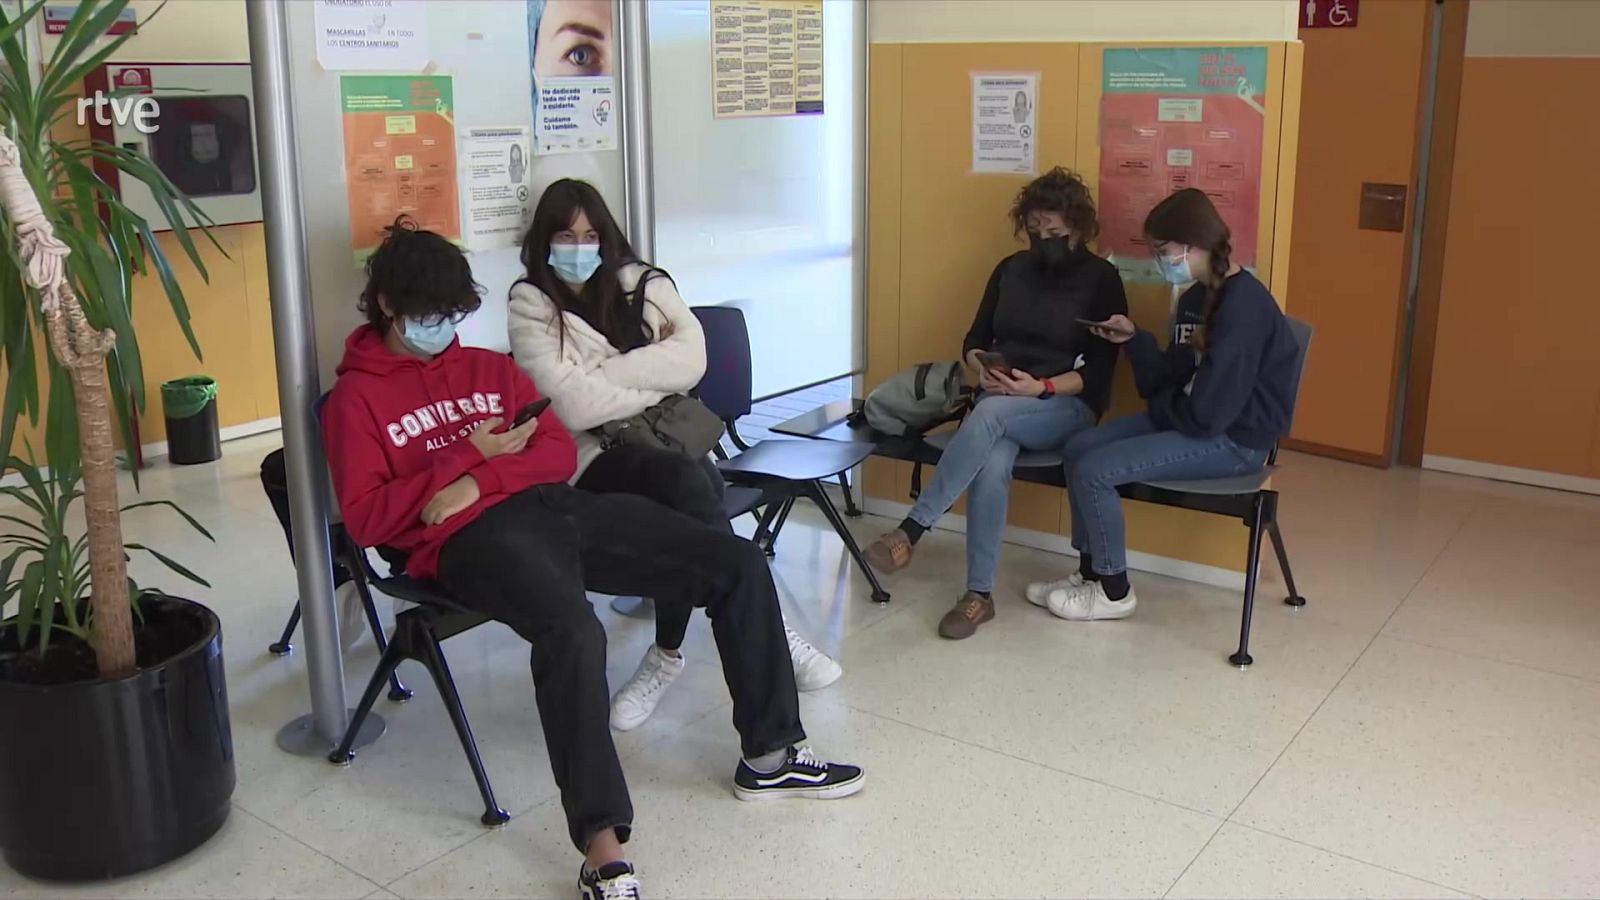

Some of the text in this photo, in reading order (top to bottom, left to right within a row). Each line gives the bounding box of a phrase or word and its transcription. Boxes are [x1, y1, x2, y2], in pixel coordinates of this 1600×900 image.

[326, 28, 366, 37] MASCARILLAS
[339, 39, 365, 47] CENTROS
[366, 40, 399, 48] SANITARIOS
[386, 392, 505, 448] CONVERSE
[426, 437, 448, 452] ALL
